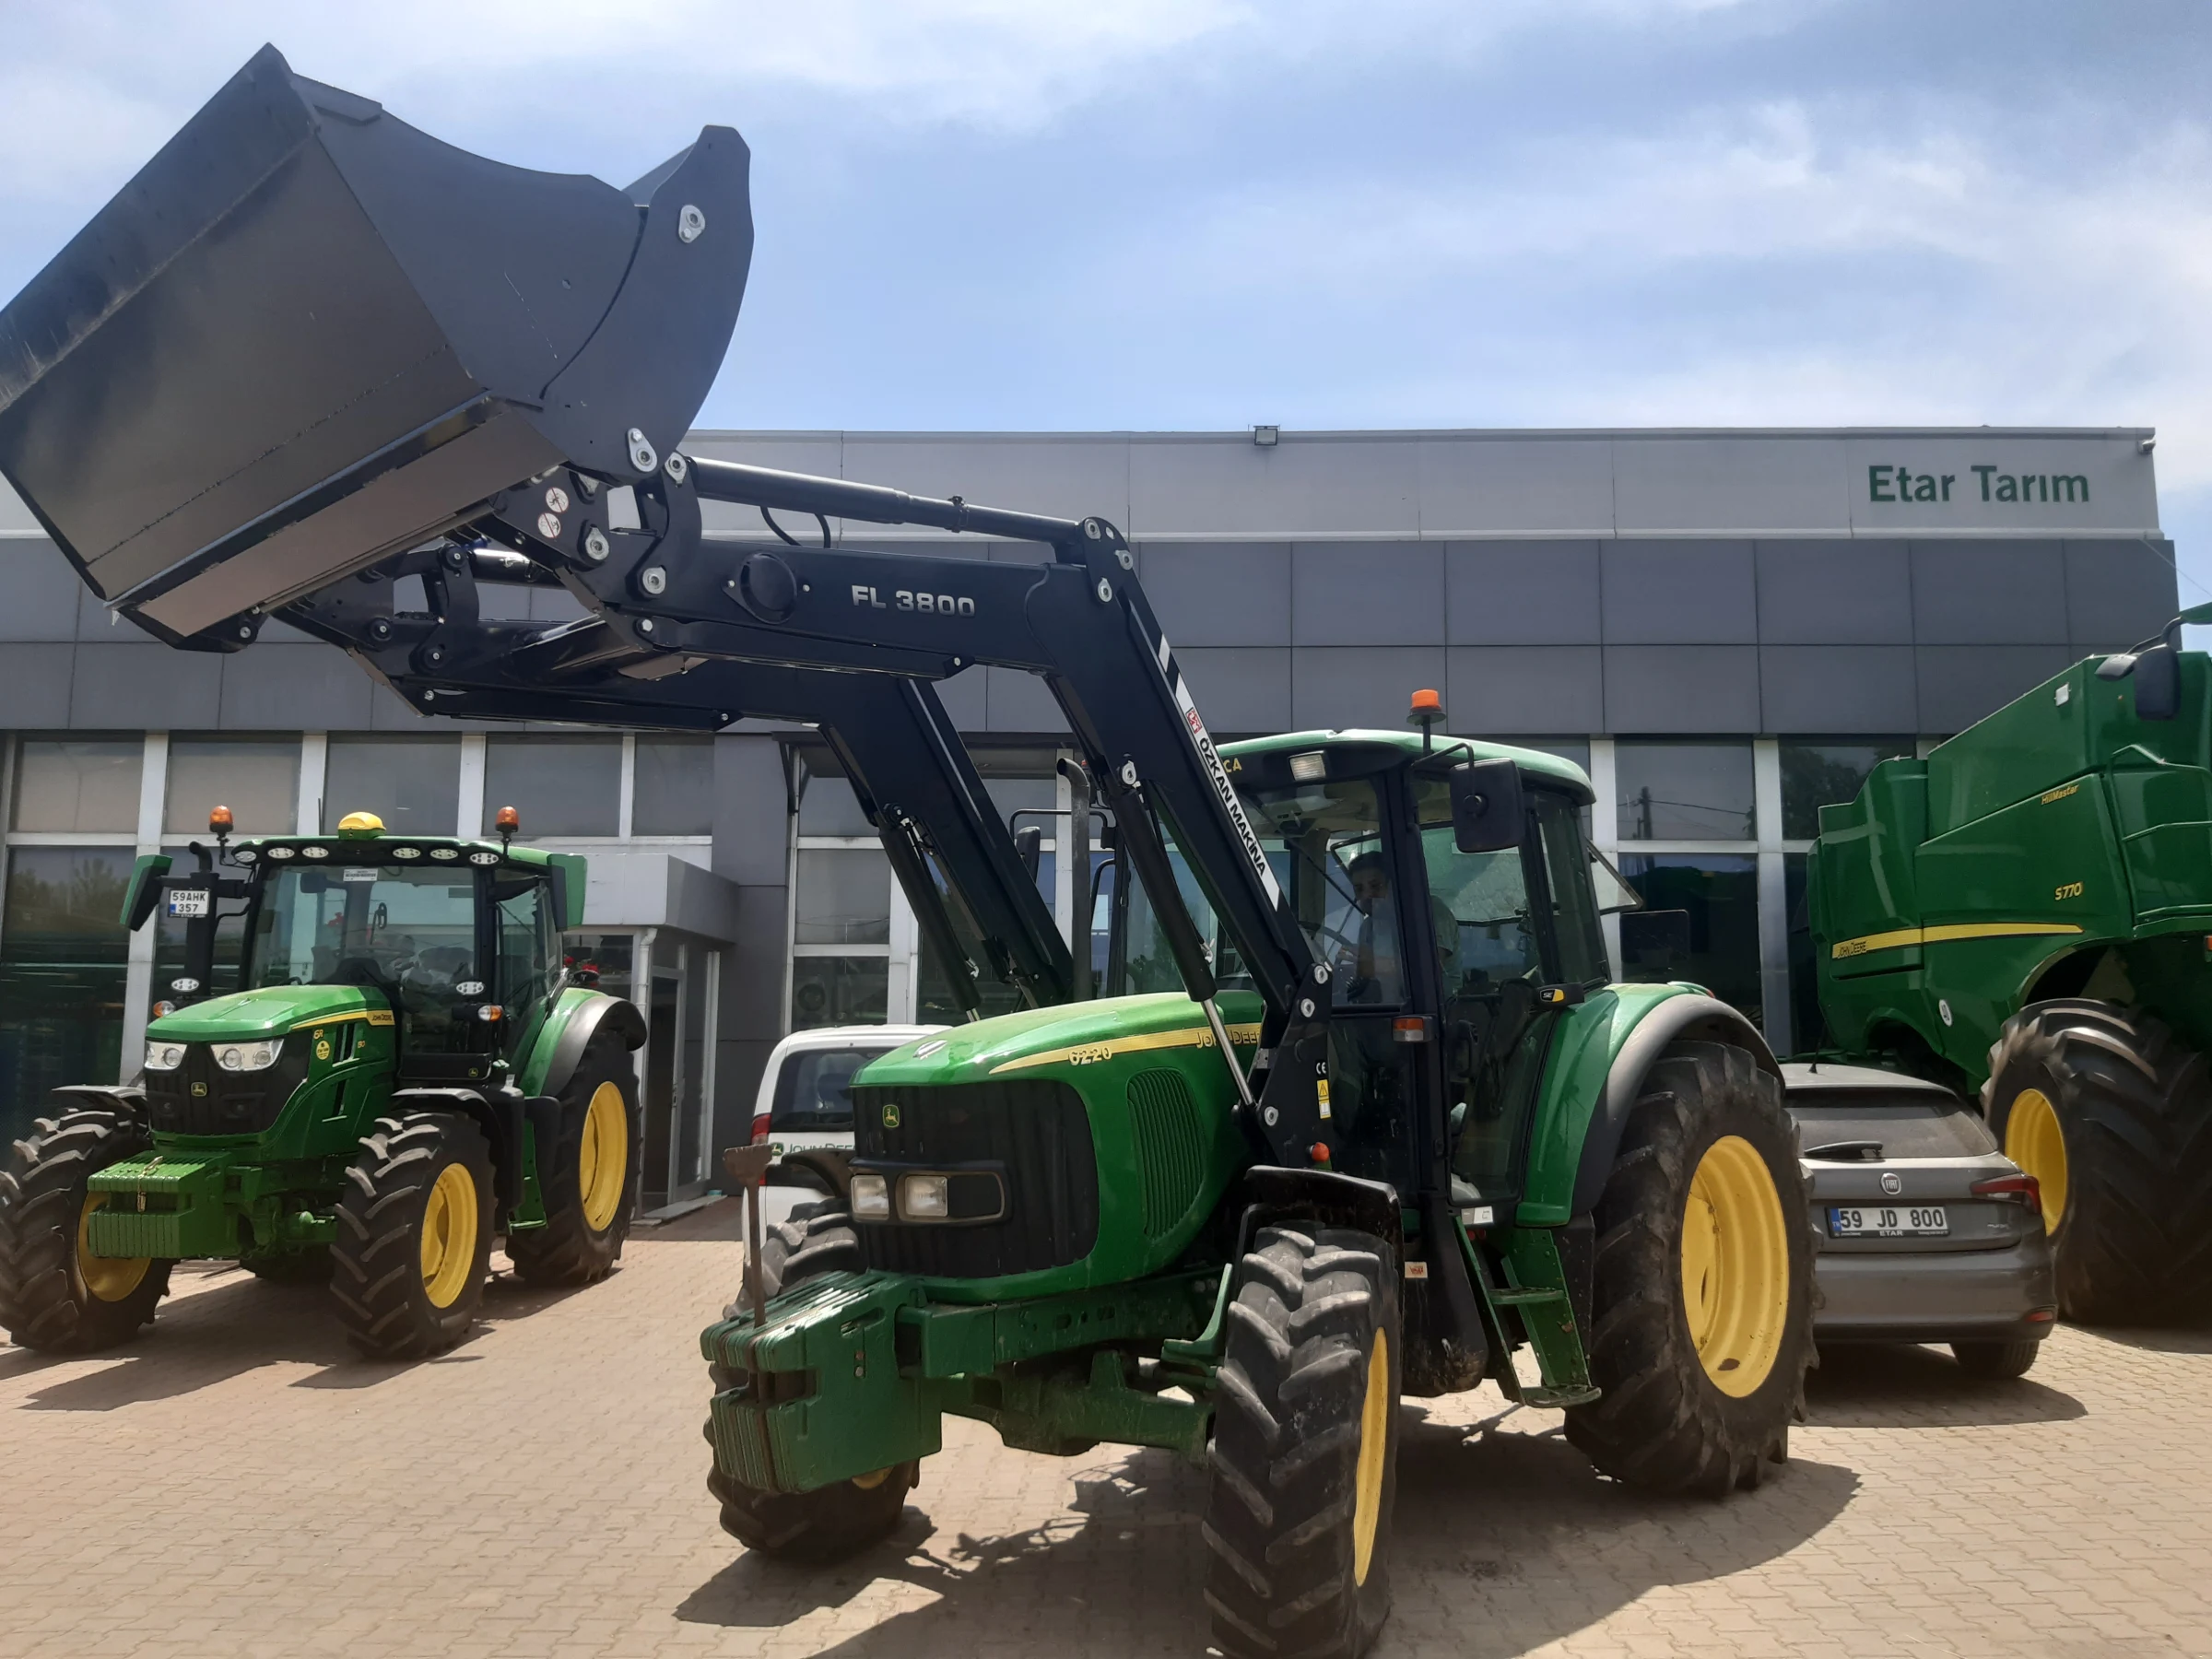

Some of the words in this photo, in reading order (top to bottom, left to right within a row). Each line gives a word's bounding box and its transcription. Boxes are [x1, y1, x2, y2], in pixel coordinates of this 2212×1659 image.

[1868, 465, 1956, 502] Etar
[1970, 465, 2089, 502] Tarım
[851, 584, 887, 609] FL
[895, 590, 975, 618] 3800
[2041, 784, 2079, 805] HillMaster
[1199, 737, 1233, 804] ÖZKAN
[1229, 803, 1266, 877] MAKİNA
[178, 903, 199, 912] 357
[1068, 1047, 1112, 1066] 6220
[1885, 1179, 1898, 1190] FIAT
[1840, 1210, 1863, 1229] 59
[1877, 1209, 1898, 1228] JD
[1910, 1208, 1944, 1228] 800
